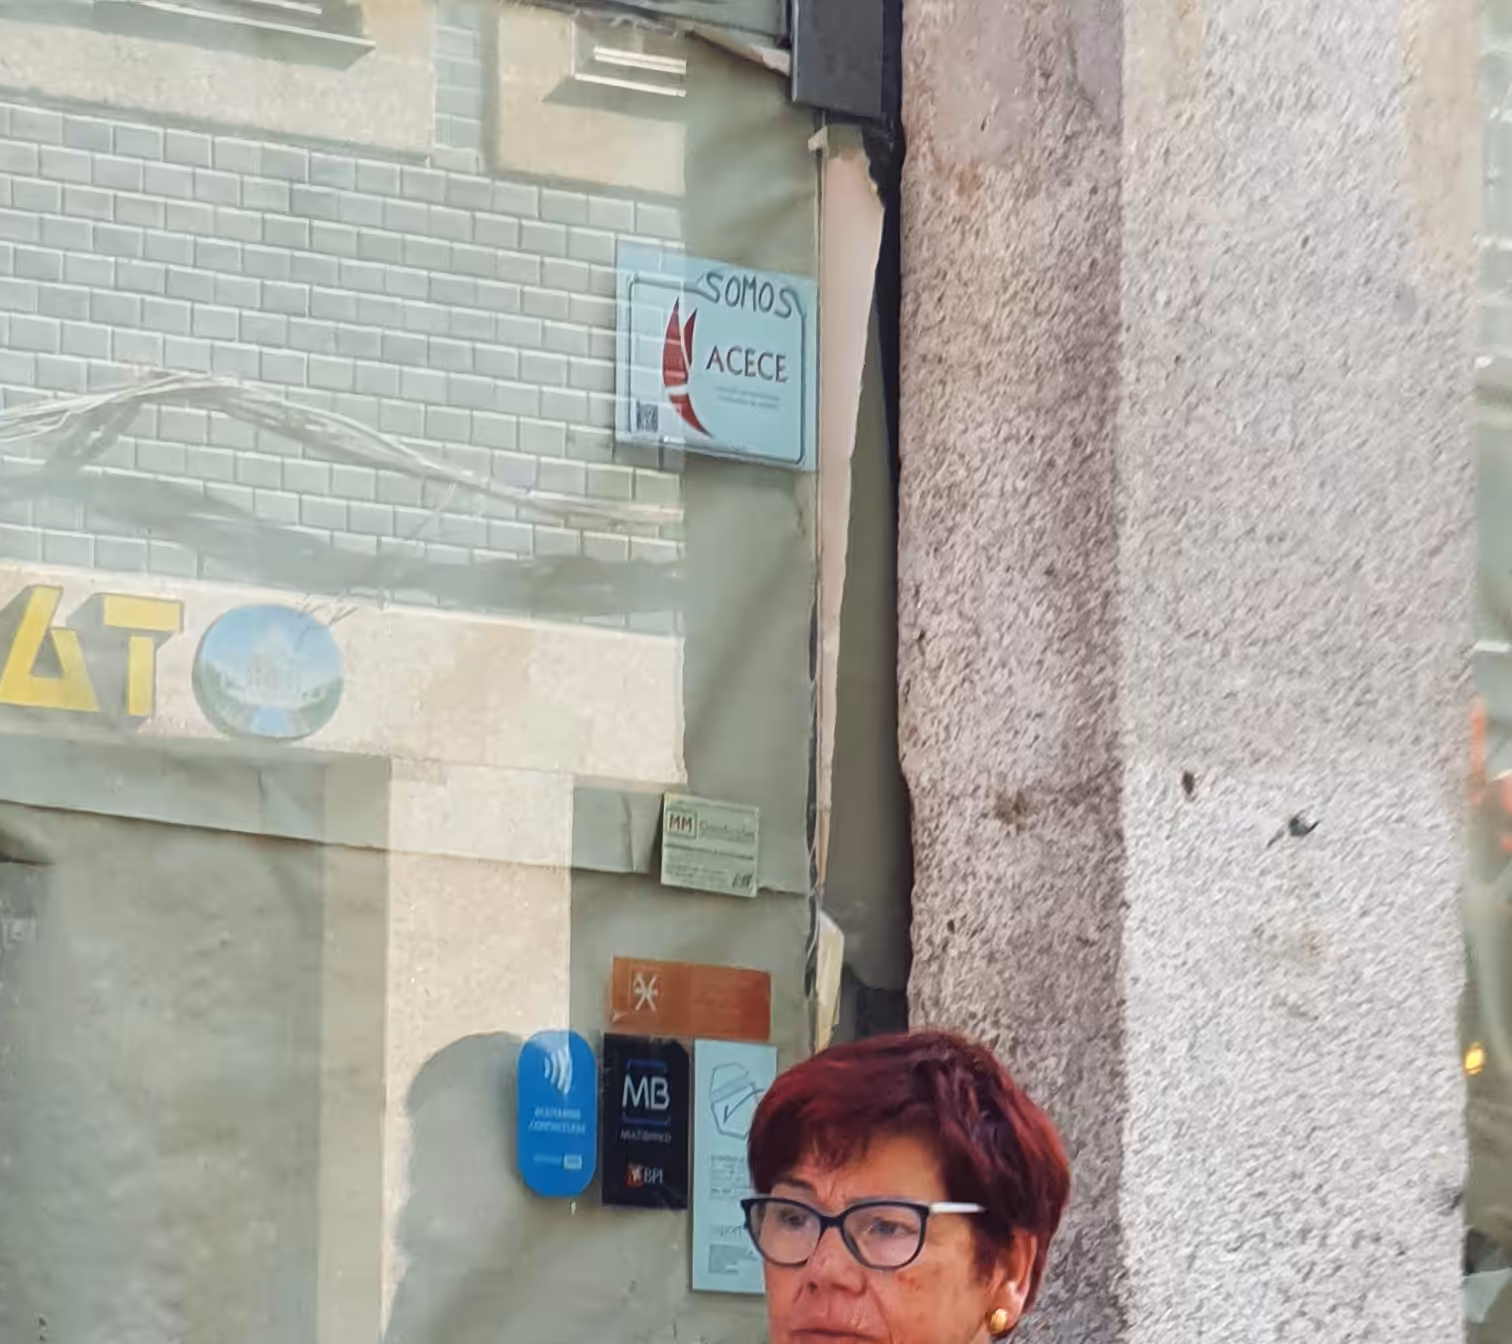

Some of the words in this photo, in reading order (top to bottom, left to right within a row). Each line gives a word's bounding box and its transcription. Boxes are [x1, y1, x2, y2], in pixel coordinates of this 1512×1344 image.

[704, 271, 795, 319] SOMOS
[705, 345, 788, 384] ACECE
[621, 1073, 671, 1111] MB
[642, 1166, 664, 1186] BPI
